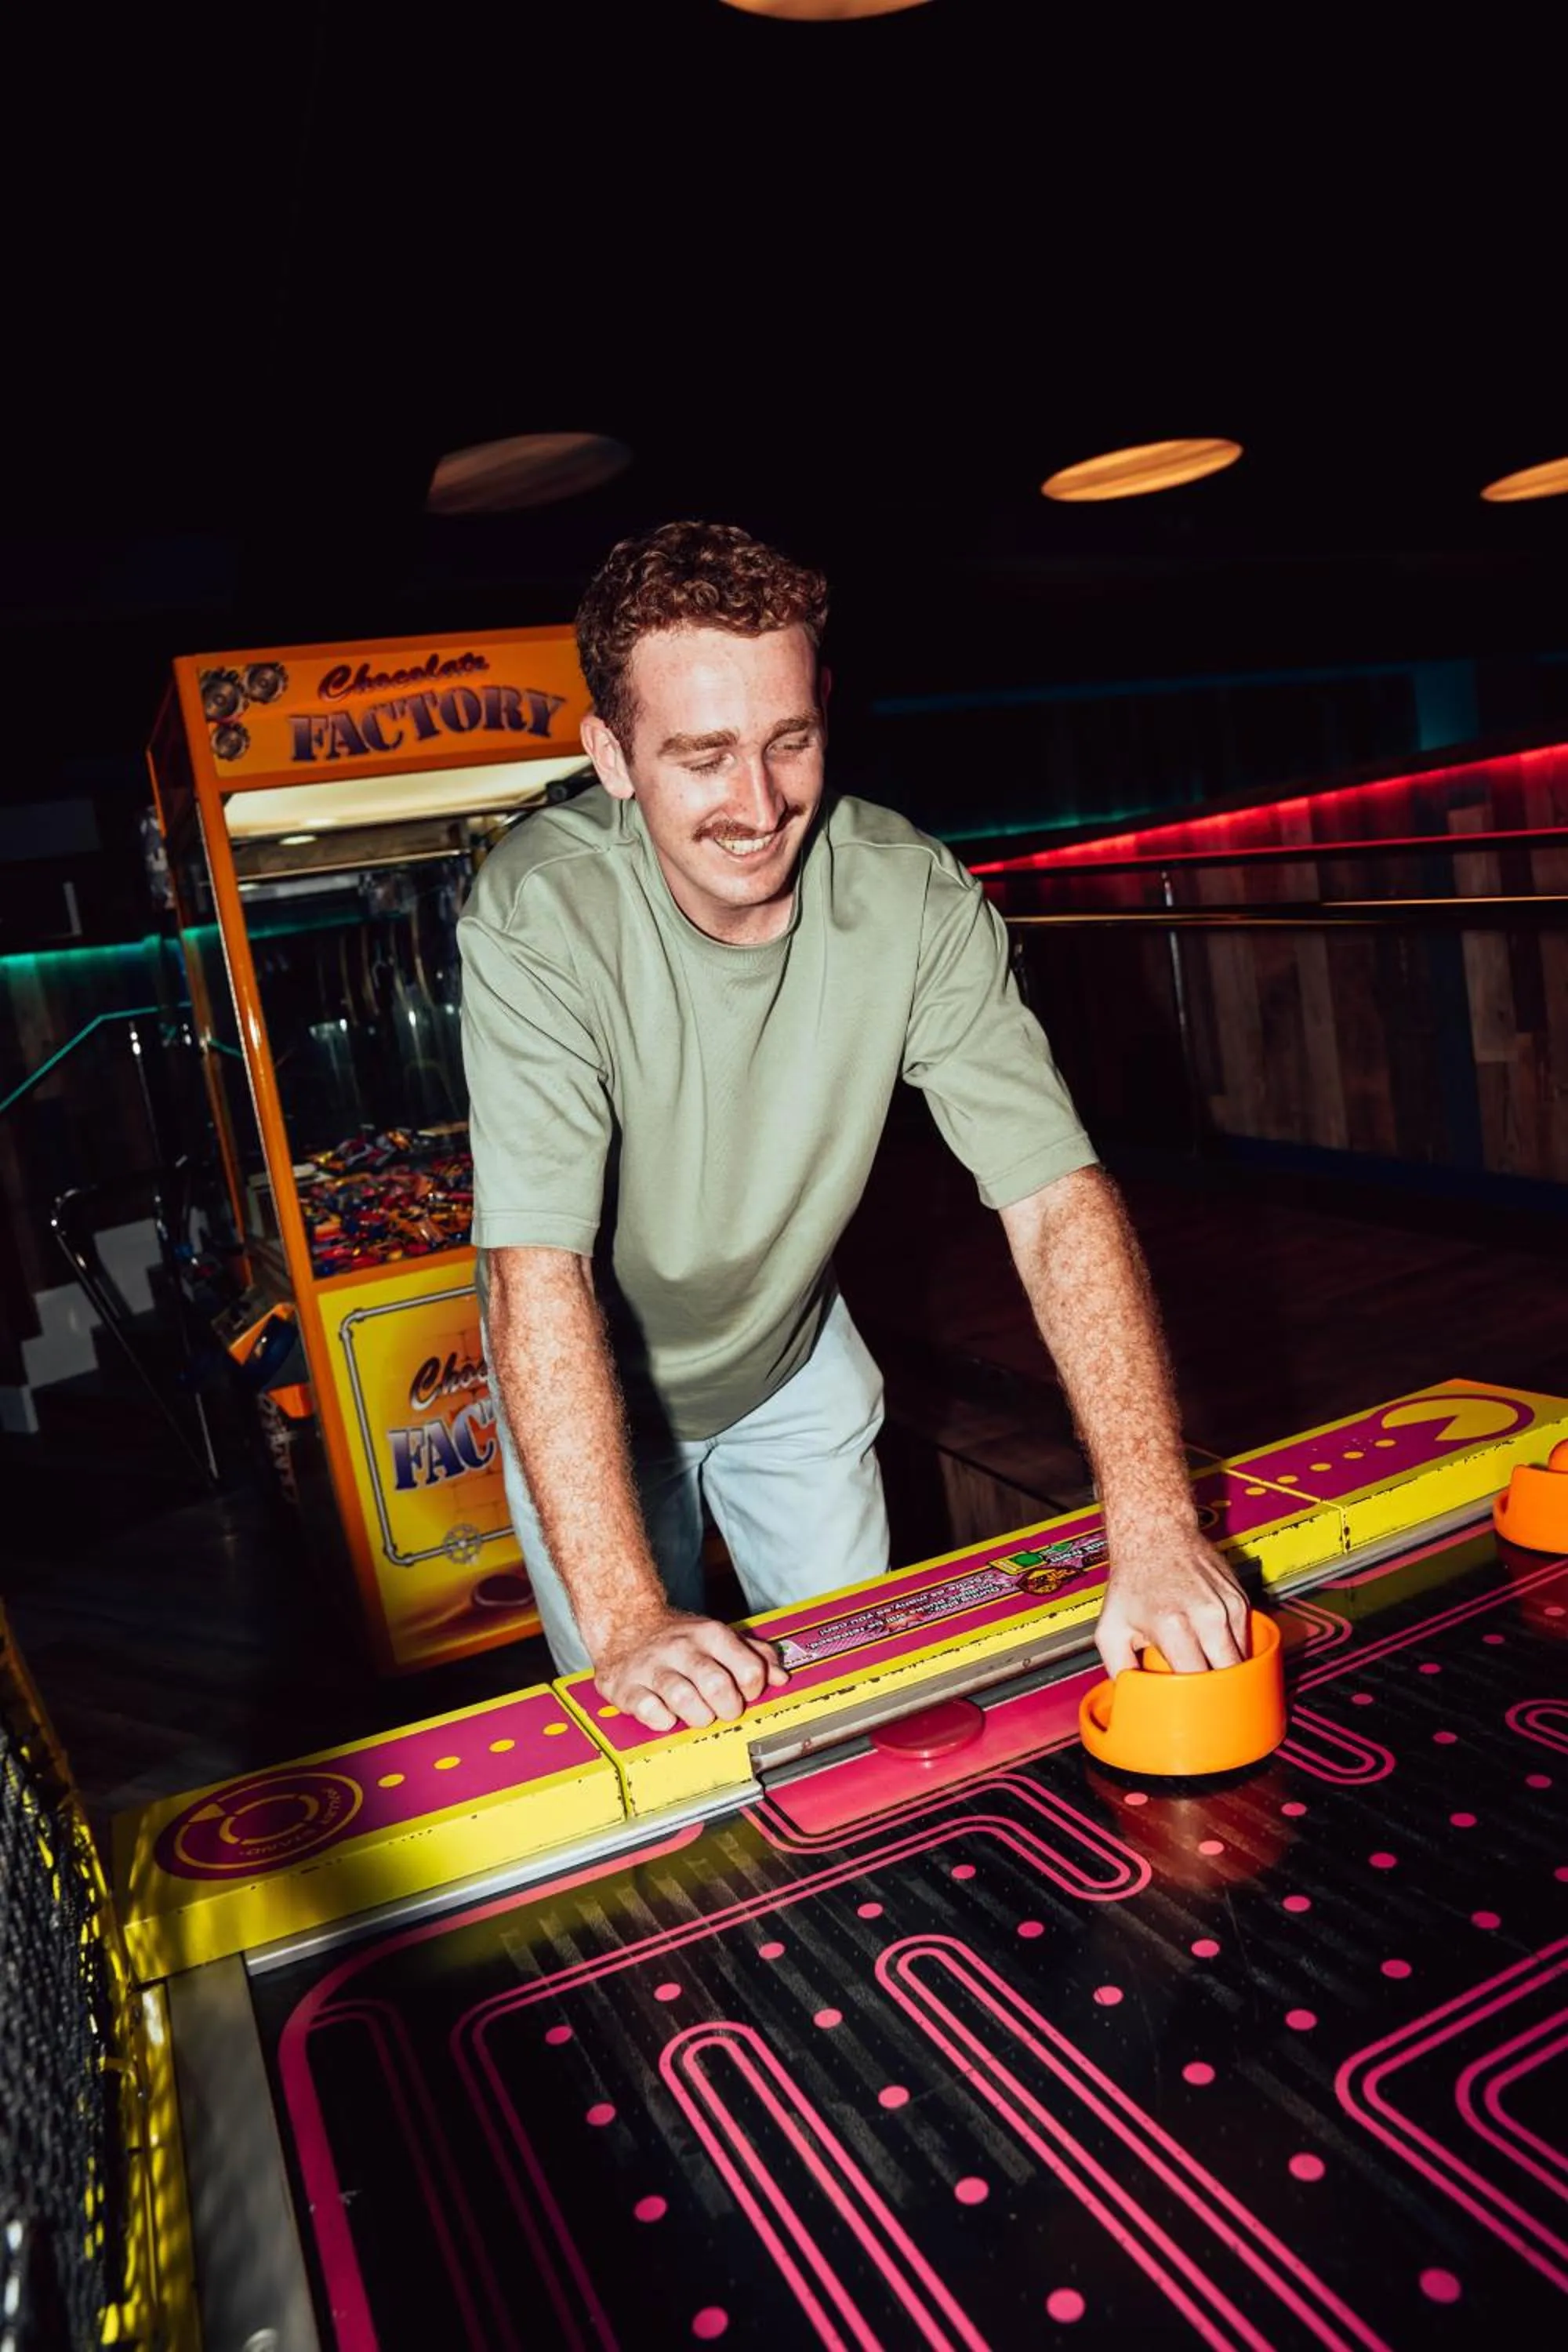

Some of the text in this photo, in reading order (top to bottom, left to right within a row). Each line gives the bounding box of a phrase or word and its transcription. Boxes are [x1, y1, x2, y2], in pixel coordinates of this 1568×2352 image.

[318, 652, 490, 702] Chocolate
[288, 685, 566, 762] FACTORY
[387, 1398, 497, 1493] FAC
